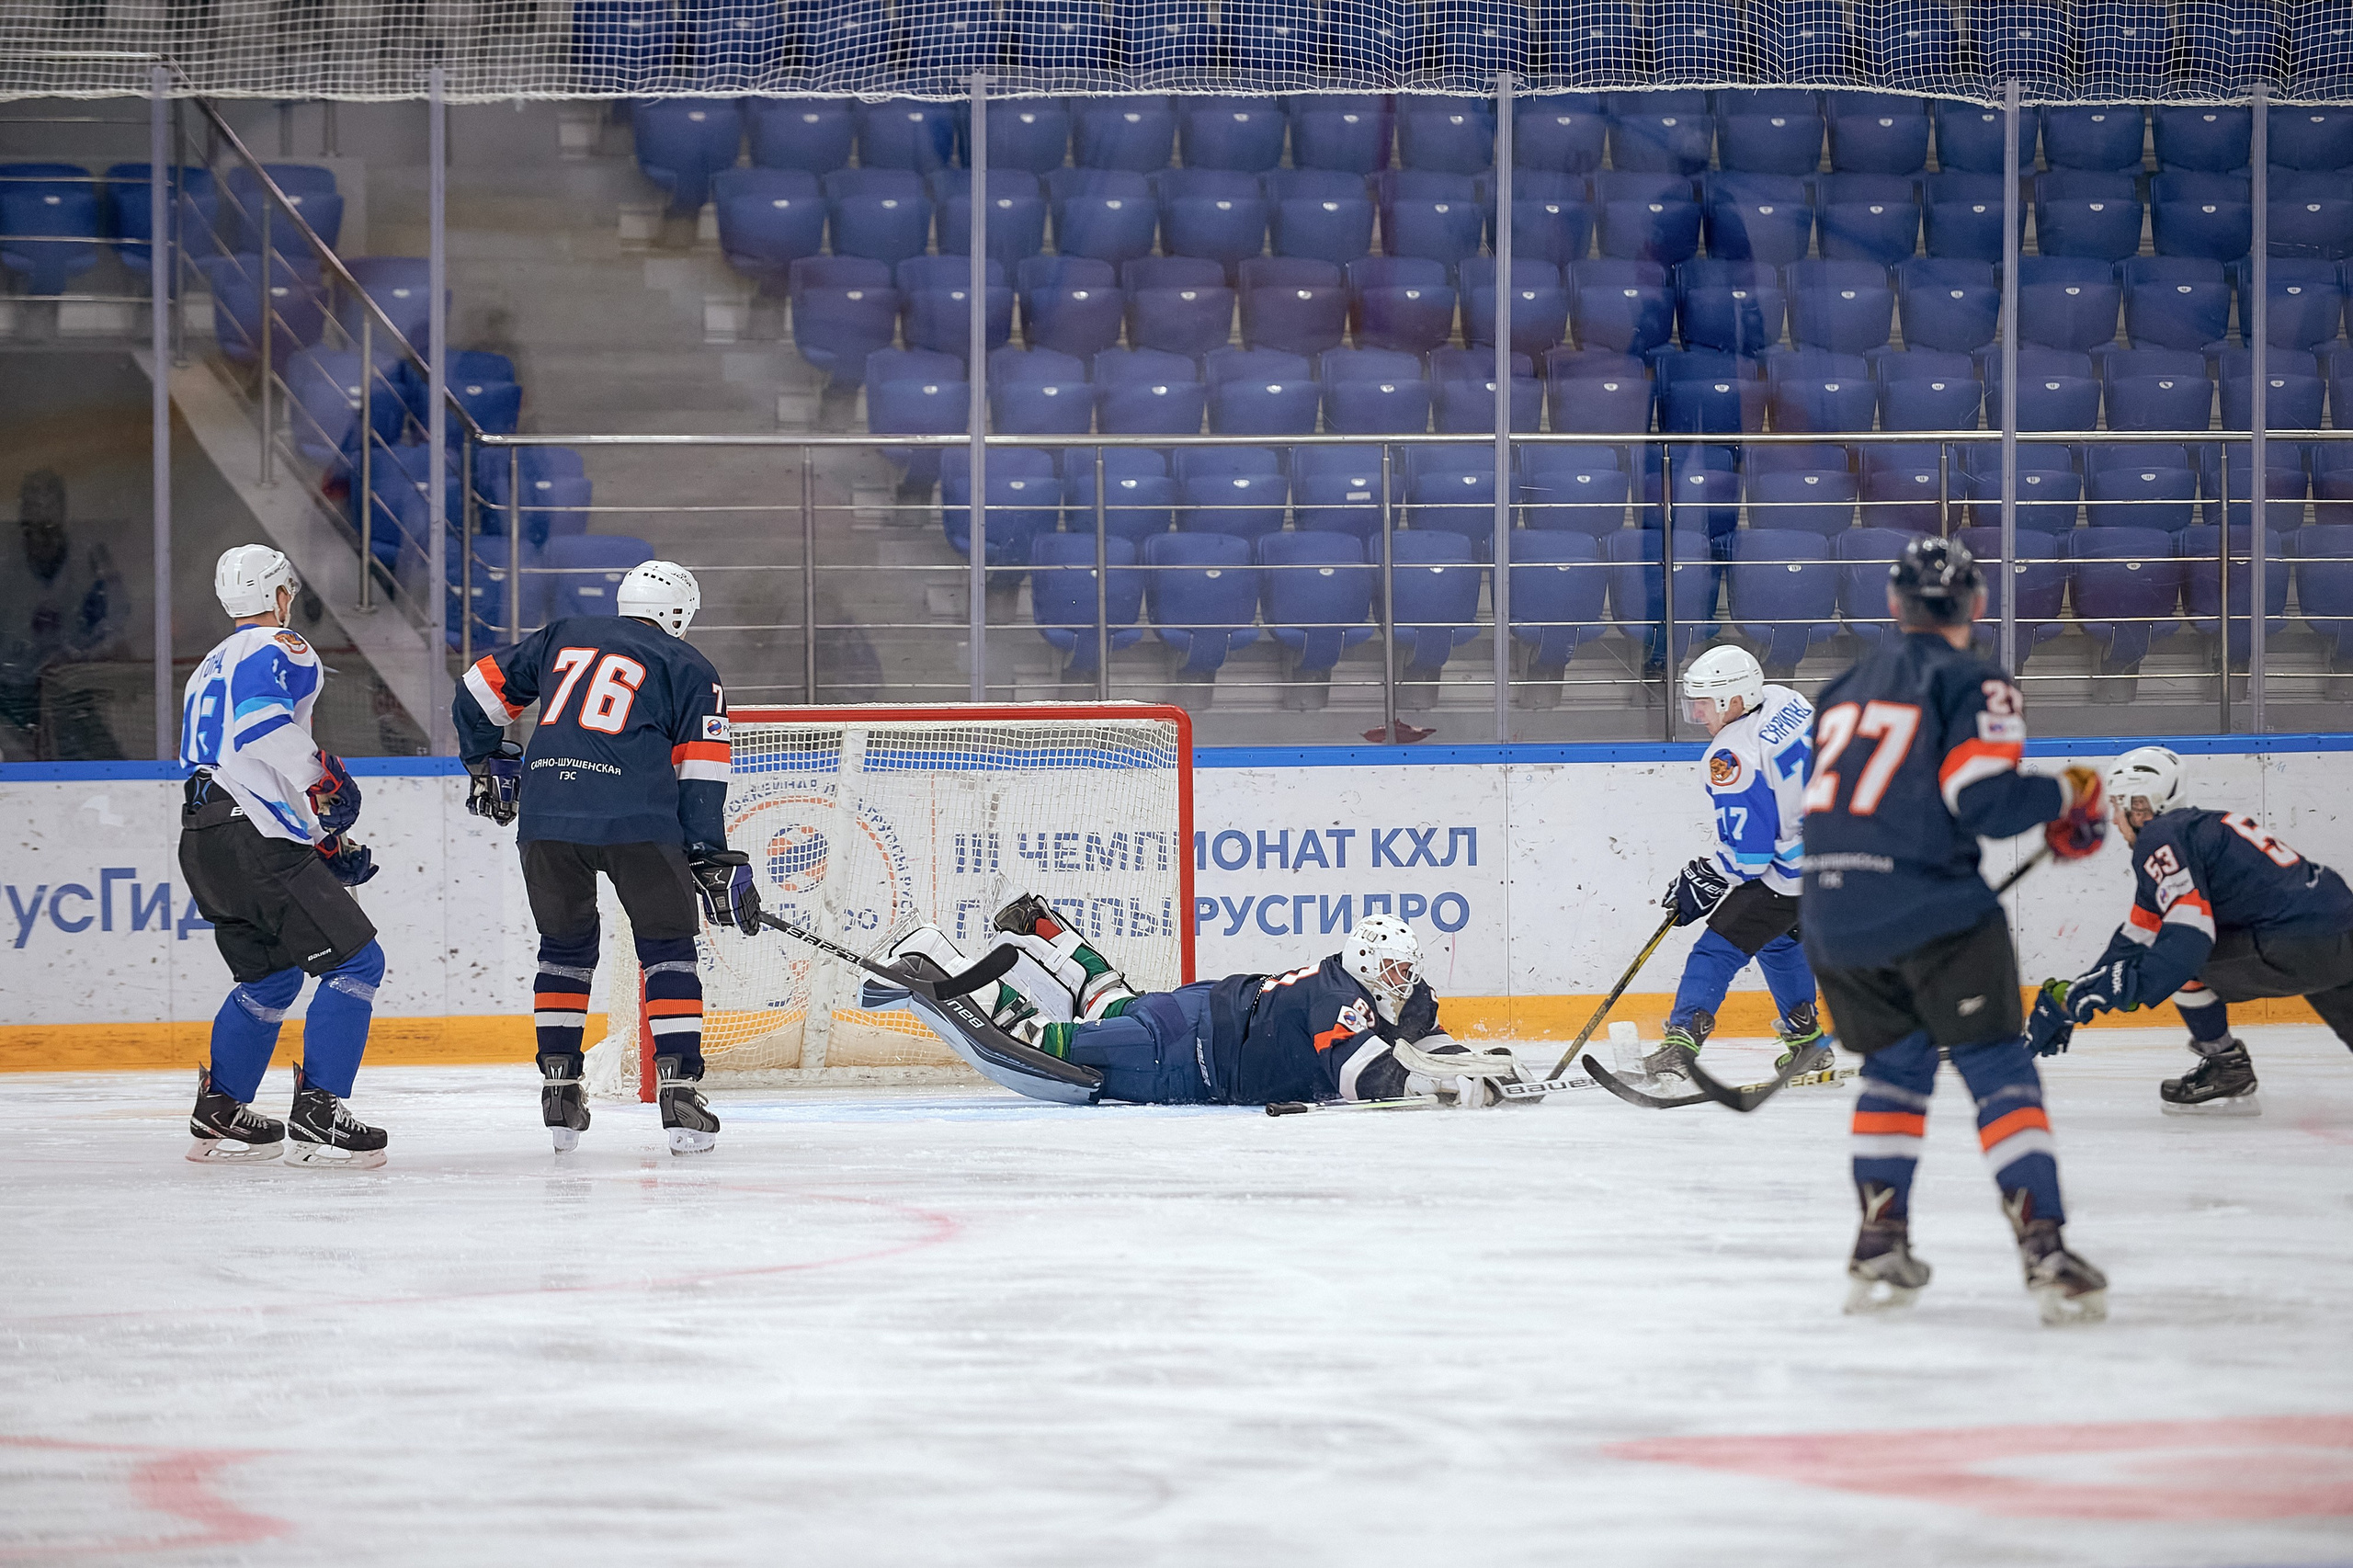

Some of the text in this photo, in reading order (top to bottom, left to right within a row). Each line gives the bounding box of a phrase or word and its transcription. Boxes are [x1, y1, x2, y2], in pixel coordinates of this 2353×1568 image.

[540, 647, 647, 734] 76
[559, 770, 577, 780] ГЭС
[1803, 695, 1923, 816] 27
[1370, 826, 1478, 869] КХЛ
[2143, 843, 2180, 886] 53
[956, 897, 1172, 940] ГППЫ
[946, 999, 986, 1029] BAU
